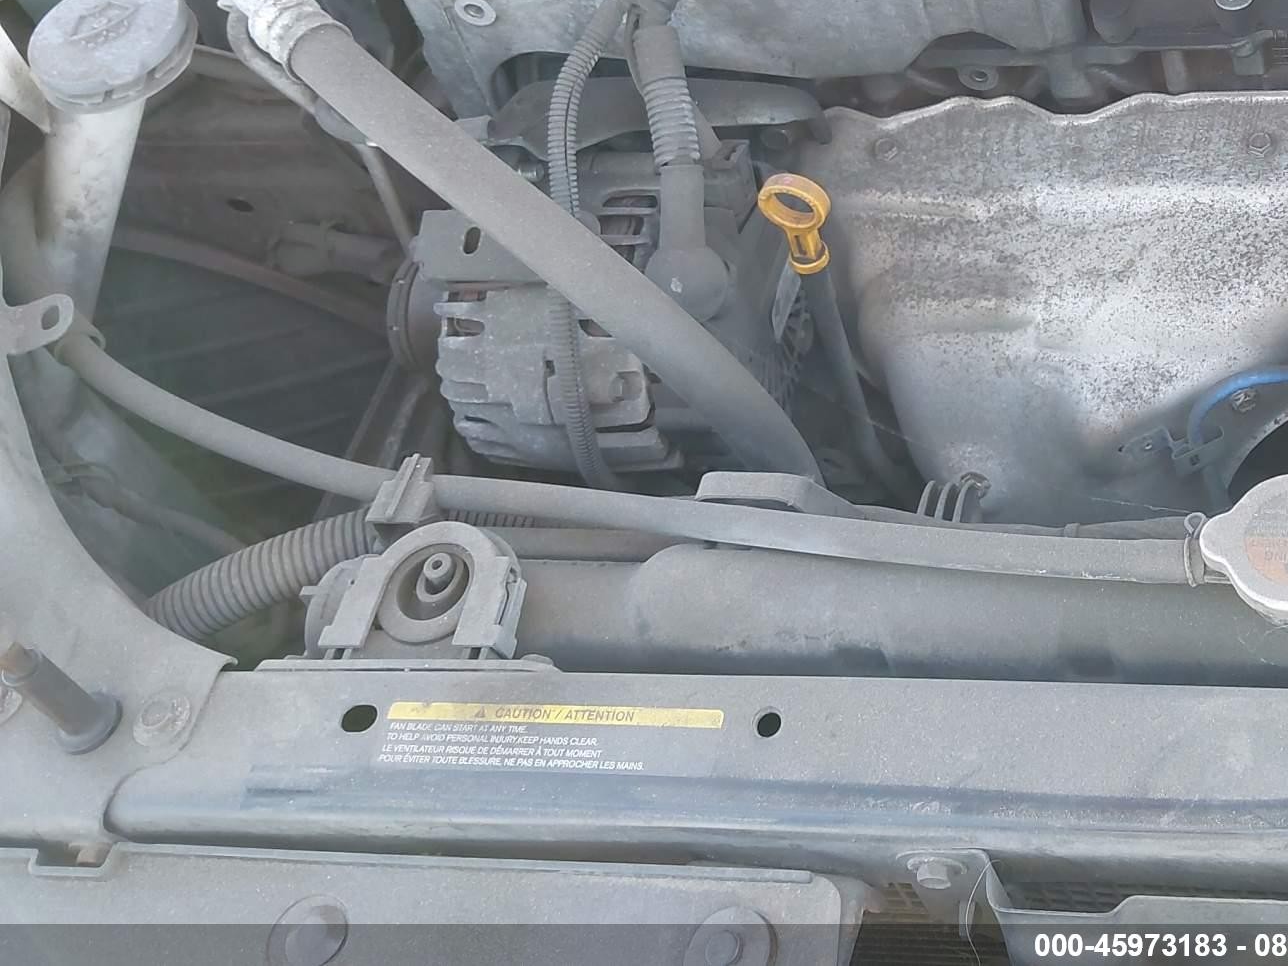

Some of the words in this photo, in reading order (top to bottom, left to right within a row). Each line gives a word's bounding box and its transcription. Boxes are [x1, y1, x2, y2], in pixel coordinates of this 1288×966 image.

[495, 707, 551, 720] CAUTION
[565, 709, 635, 722] ATTENTION
[390, 722, 406, 731] FAN
[406, 722, 431, 731] BLADE
[434, 723, 452, 731] CAN
[452, 724, 478, 733] START
[490, 725, 506, 733] ANY
[399, 733, 419, 741] HELP
[421, 734, 445, 742] AVOID
[446, 734, 488, 743] PERSONAL
[540, 736, 568, 745] HANDS
[382, 744, 392, 752] LE
[394, 744, 444, 753] VENTILATEUR
[445, 745, 476, 754] RISQUE
[478, 746, 488, 754] DE
[490, 744, 535, 756] DÉMARRER
[535, 745, 542, 756] À
[543, 748, 566, 757] TOUT
[566, 749, 602, 758] MOMENT
[378, 754, 402, 763] POUR
[403, 753, 430, 763] ÉVITER
[432, 755, 458, 764] TOUTE
[504, 758, 516, 766] NE
[517, 758, 533, 766] PAS
[534, 759, 546, 767] EN
[547, 759, 600, 769] APPROCHER
[600, 760, 615, 769] LES
[617, 761, 644, 770] MAINS.
